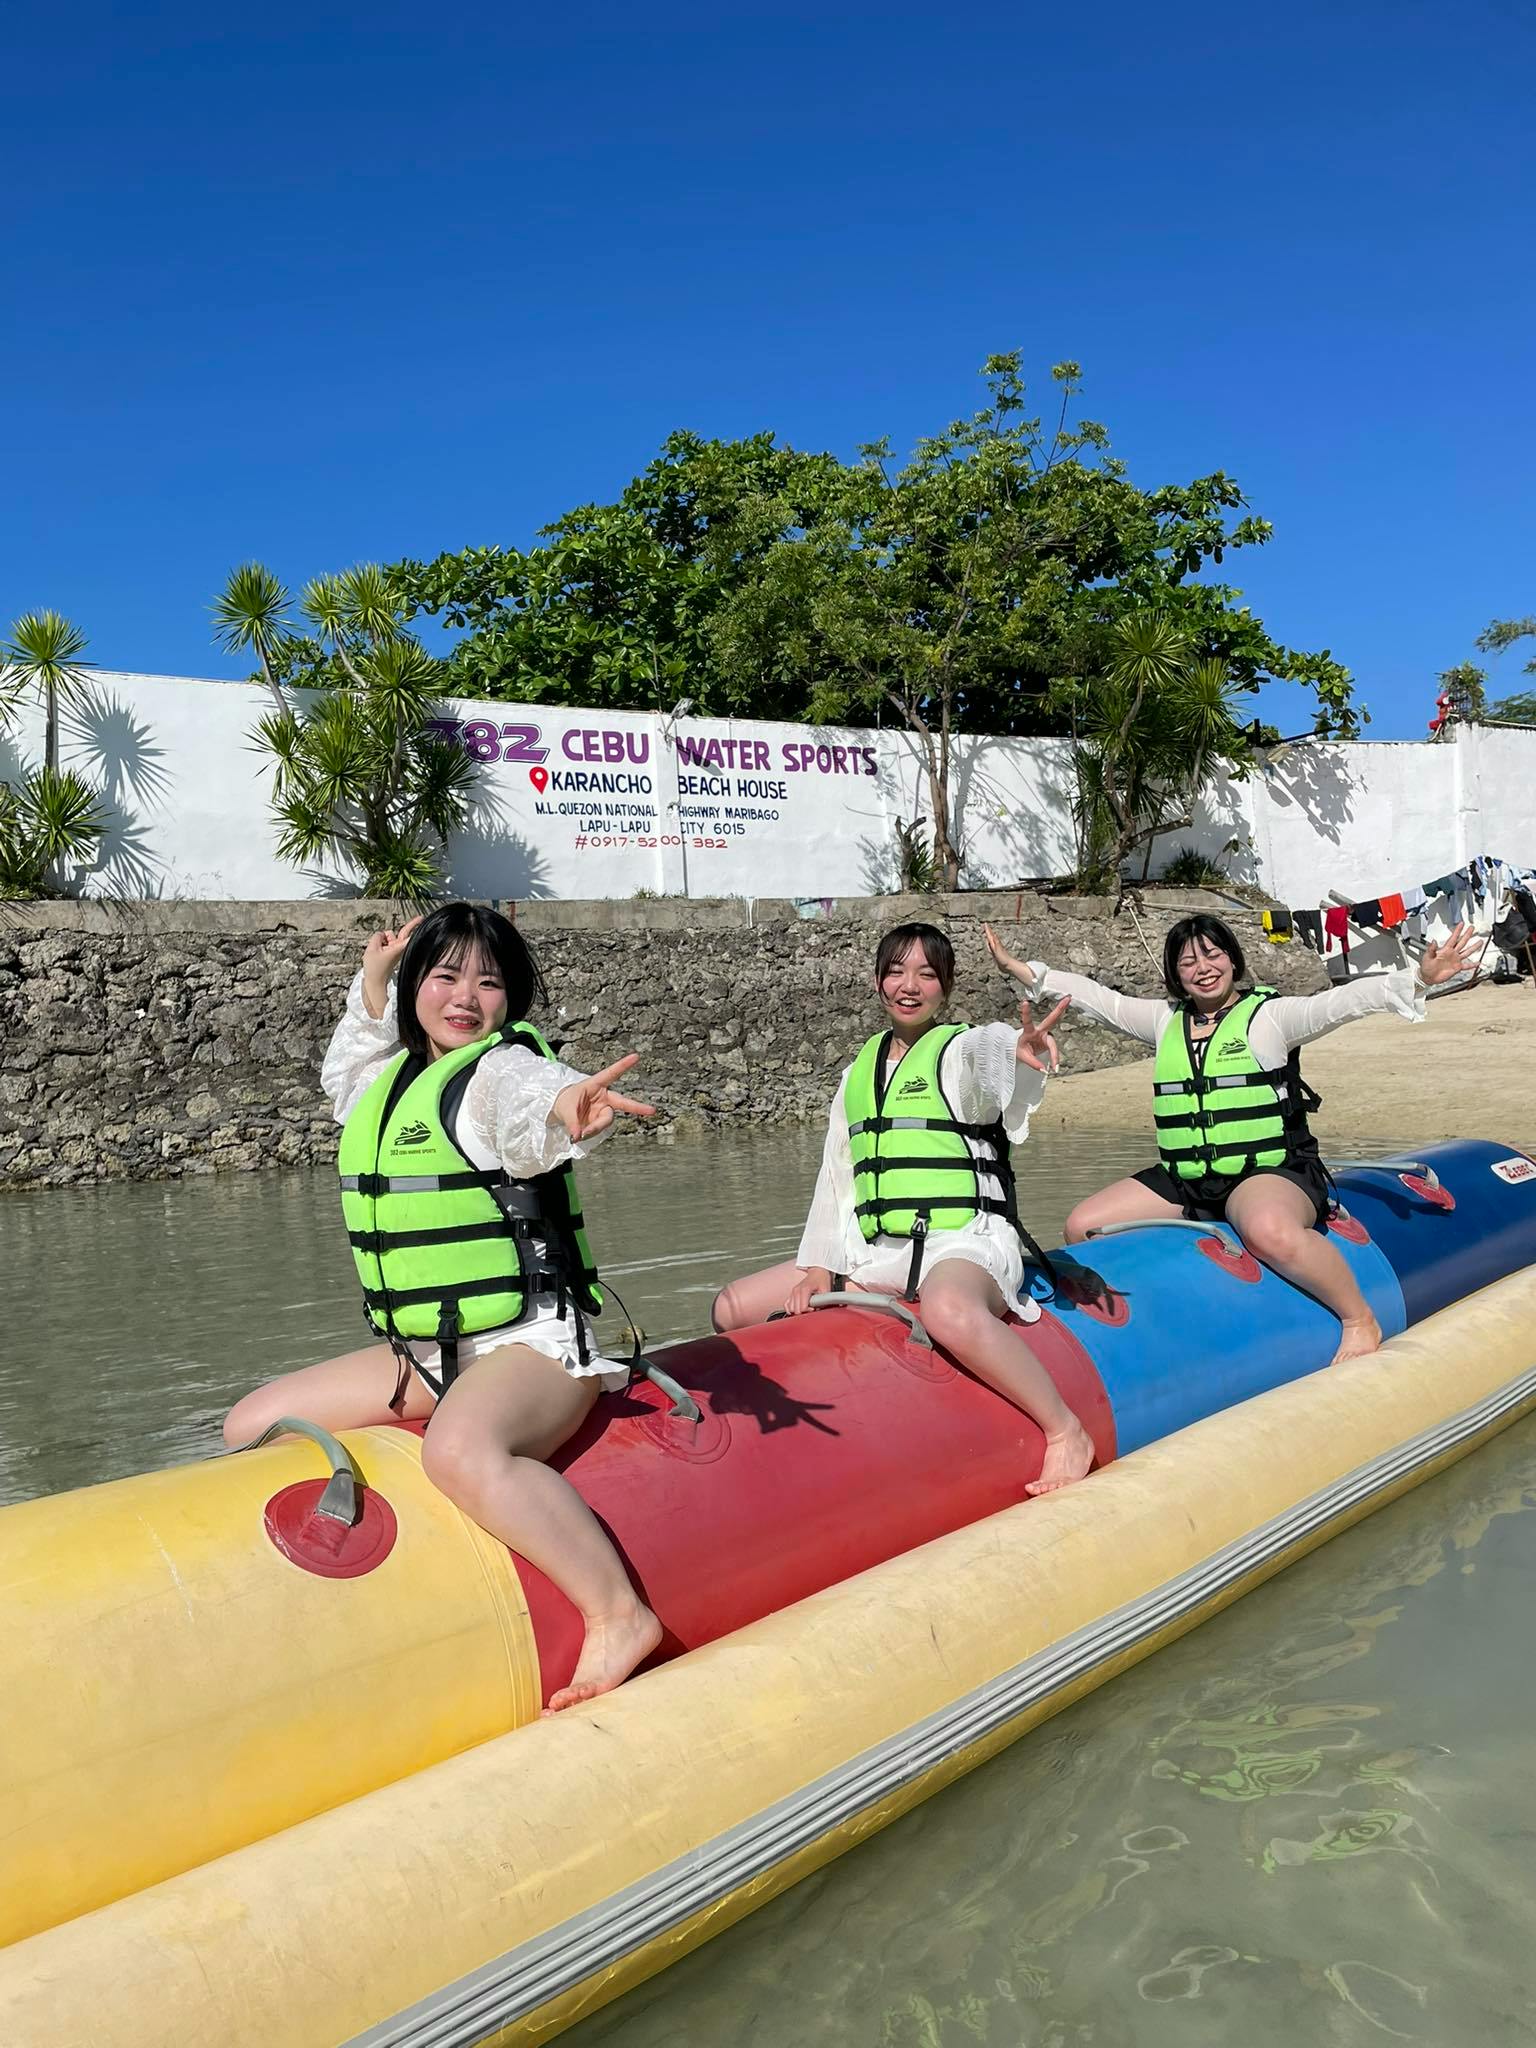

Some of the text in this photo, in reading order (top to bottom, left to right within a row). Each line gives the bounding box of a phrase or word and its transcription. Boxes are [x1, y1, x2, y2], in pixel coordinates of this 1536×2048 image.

[561, 729, 649, 764] CEBU
[676, 736, 771, 771] WATER
[782, 743, 878, 776] SPORTS
[551, 771, 788, 800] KARANCHO BEACH HOUSE
[605, 803, 658, 817] NATIONAL
[678, 806, 720, 818] HIGHWAY
[725, 807, 779, 820] MARIBAGO
[680, 821, 704, 834] CITY
[713, 823, 746, 835] 6015
